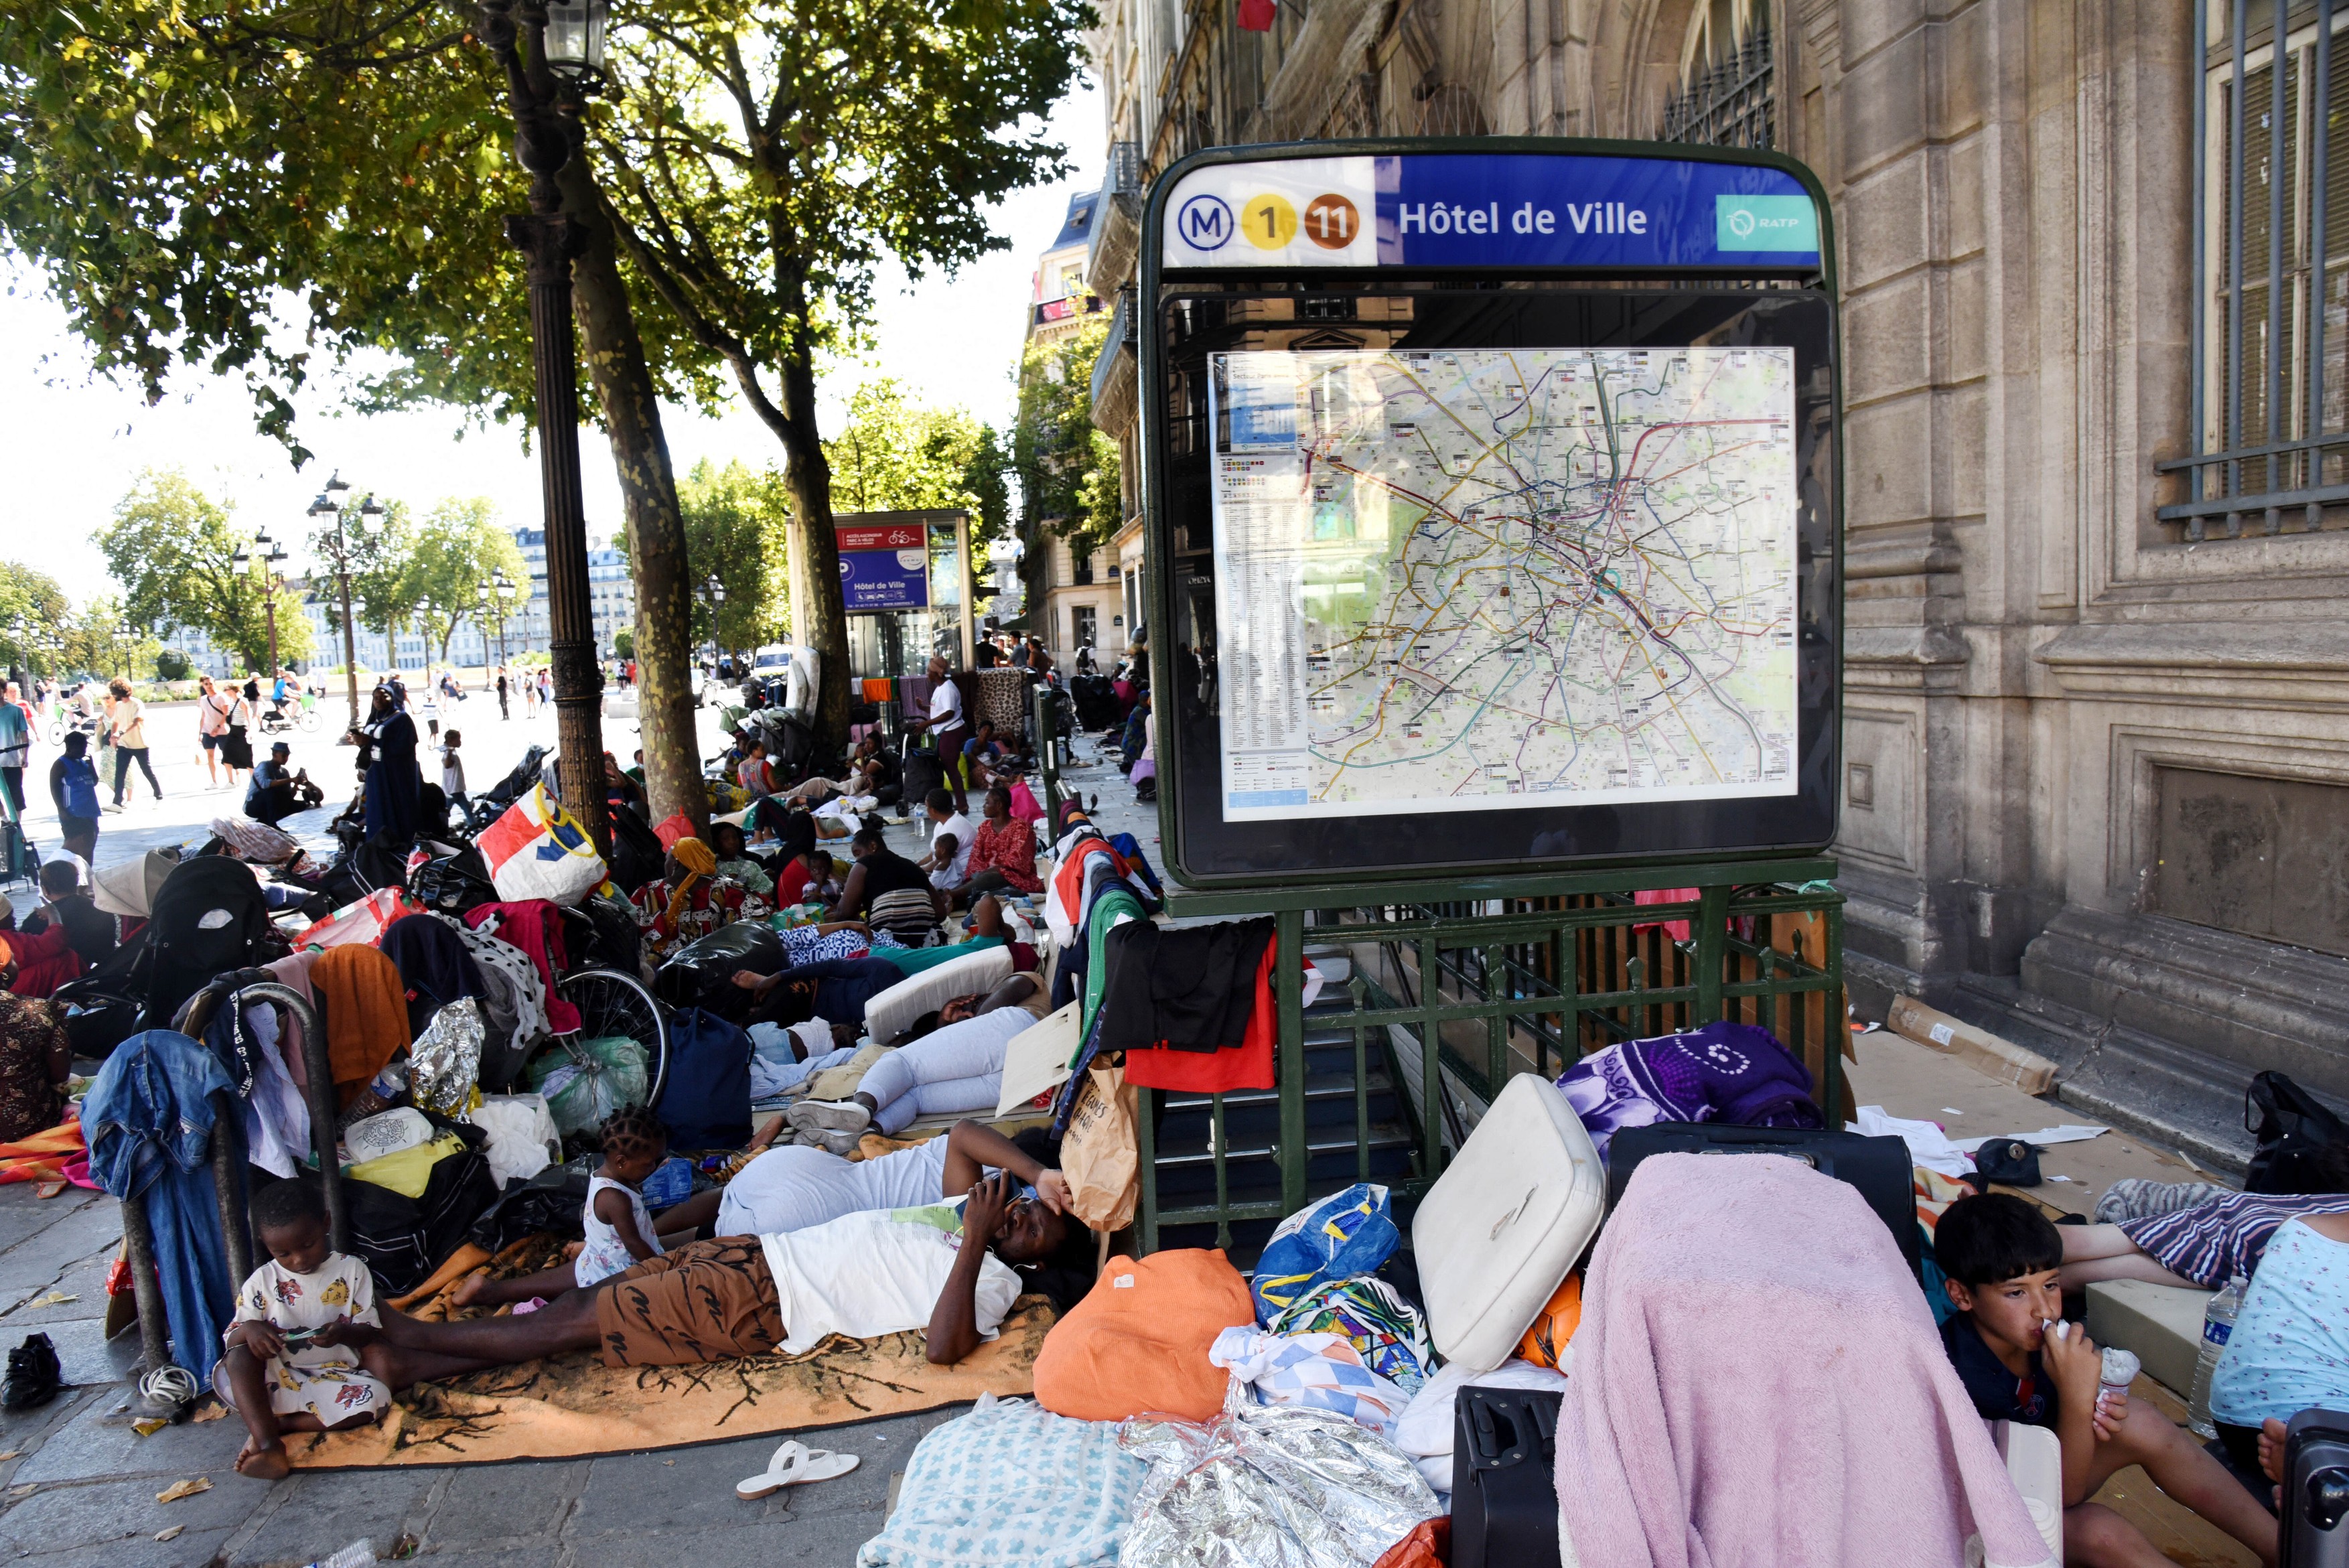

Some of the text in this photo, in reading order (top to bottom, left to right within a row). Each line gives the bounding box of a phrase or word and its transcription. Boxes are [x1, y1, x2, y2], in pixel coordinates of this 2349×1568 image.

[1259, 206, 1275, 238] 1
[1311, 206, 1348, 238] 11
[1399, 202, 1648, 234] Hôtel de Ville
[1759, 218, 1799, 228] RATP
